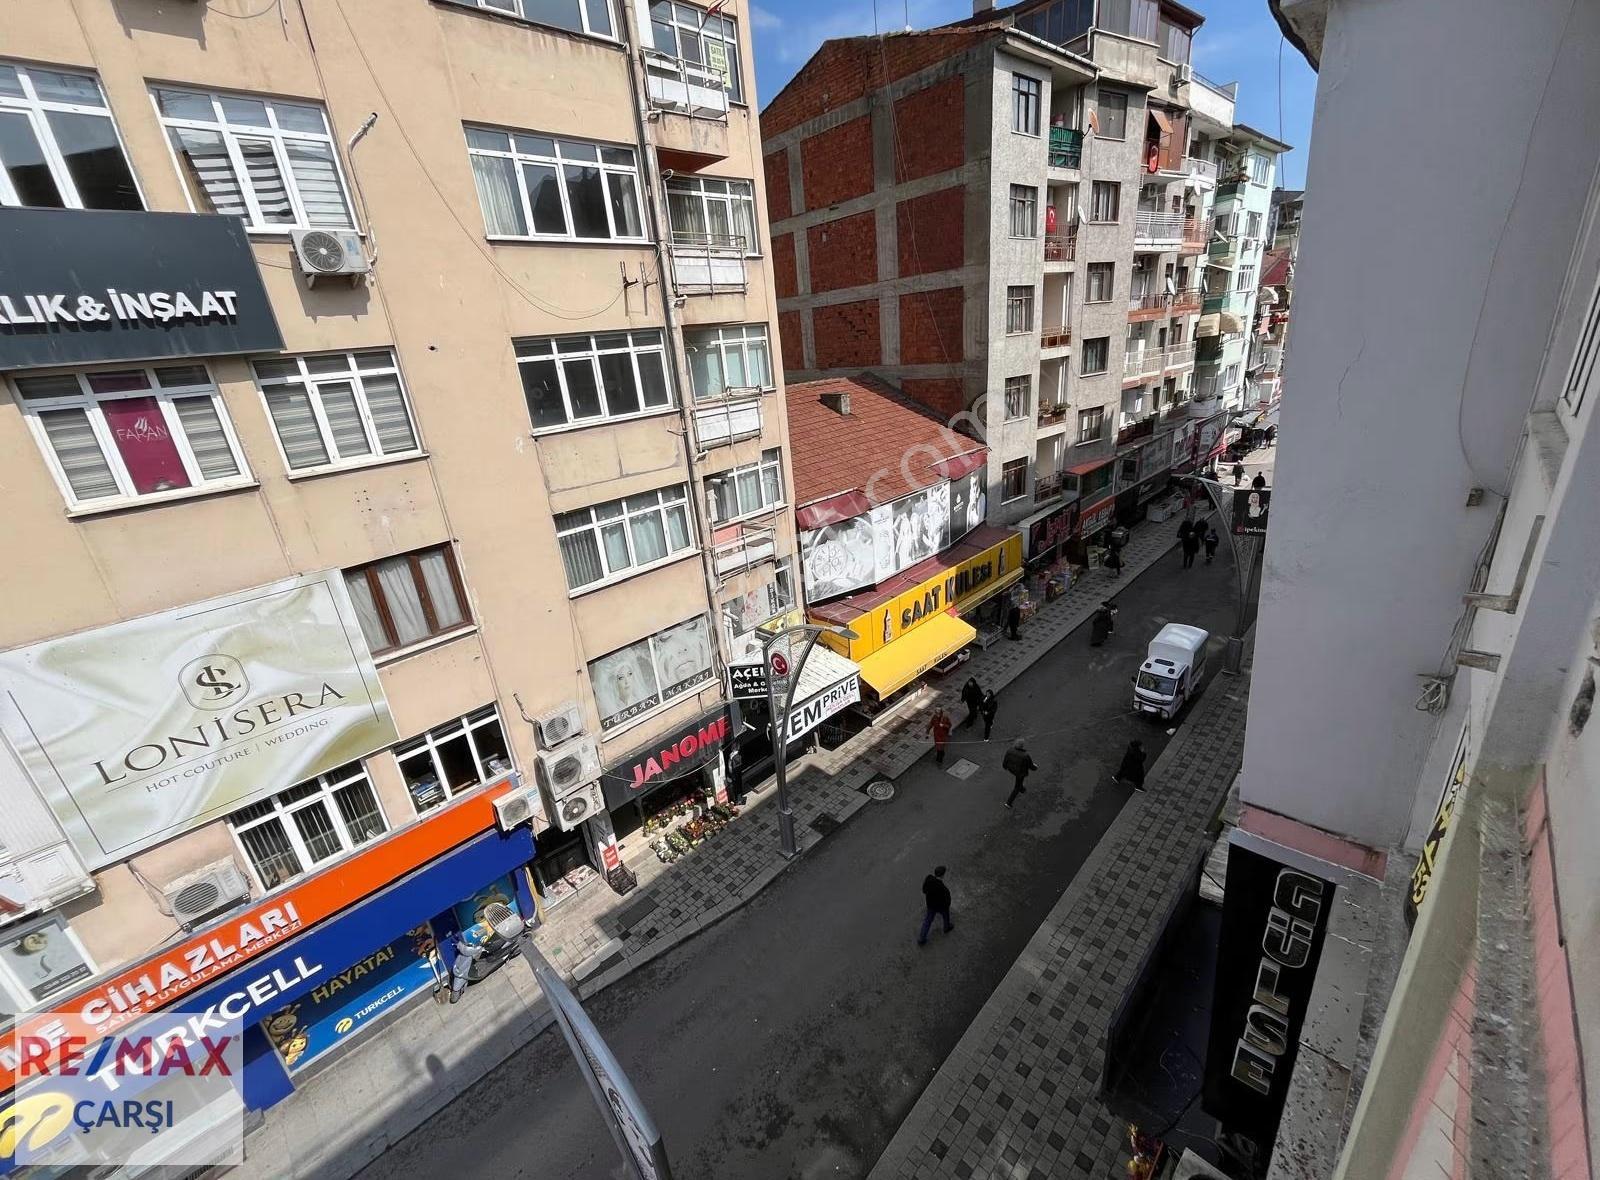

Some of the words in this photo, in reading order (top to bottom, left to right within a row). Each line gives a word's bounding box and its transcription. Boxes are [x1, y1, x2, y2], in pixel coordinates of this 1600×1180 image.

[107, 288, 237, 323] İNŞAAT
[901, 584, 943, 630] SAAT
[92, 680, 345, 786] LONİSERA
[146, 774, 183, 793] HOT
[183, 746, 251, 779] COUTURE
[264, 718, 329, 747] WEDDING
[80, 901, 300, 1026] CİHAZLARI
[158, 953, 243, 1004] UYGULAMA
[311, 945, 396, 1005] HAYATA!
[87, 955, 323, 1092] TURKCELL
[353, 985, 405, 1020] TURKCELL
